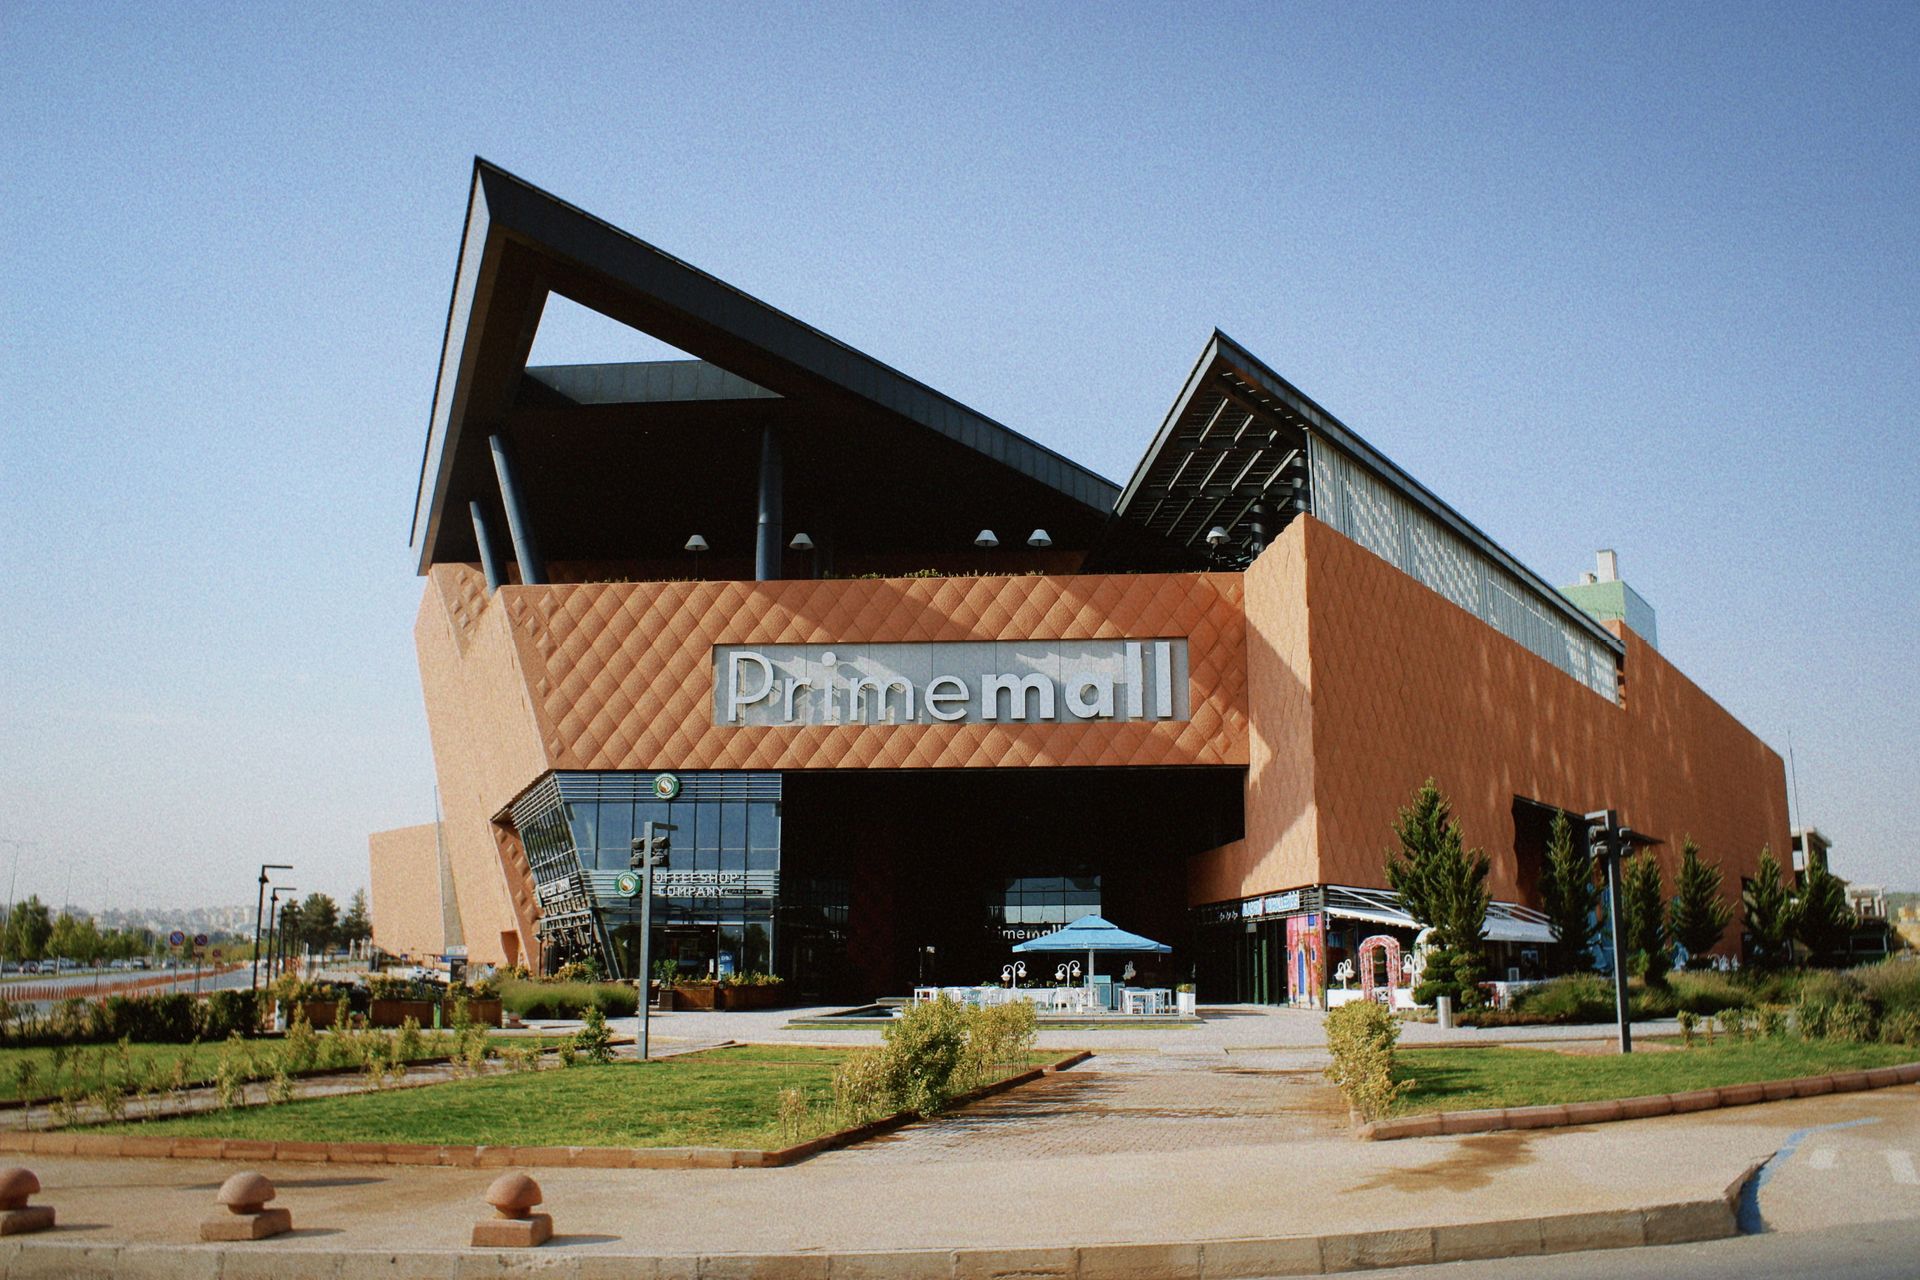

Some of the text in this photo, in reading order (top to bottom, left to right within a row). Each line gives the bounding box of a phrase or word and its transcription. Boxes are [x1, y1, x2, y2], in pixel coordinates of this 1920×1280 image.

[727, 641, 1172, 721] Primemall
[654, 872, 738, 883] OFFEESHOP
[658, 886, 724, 897] COMPANY
